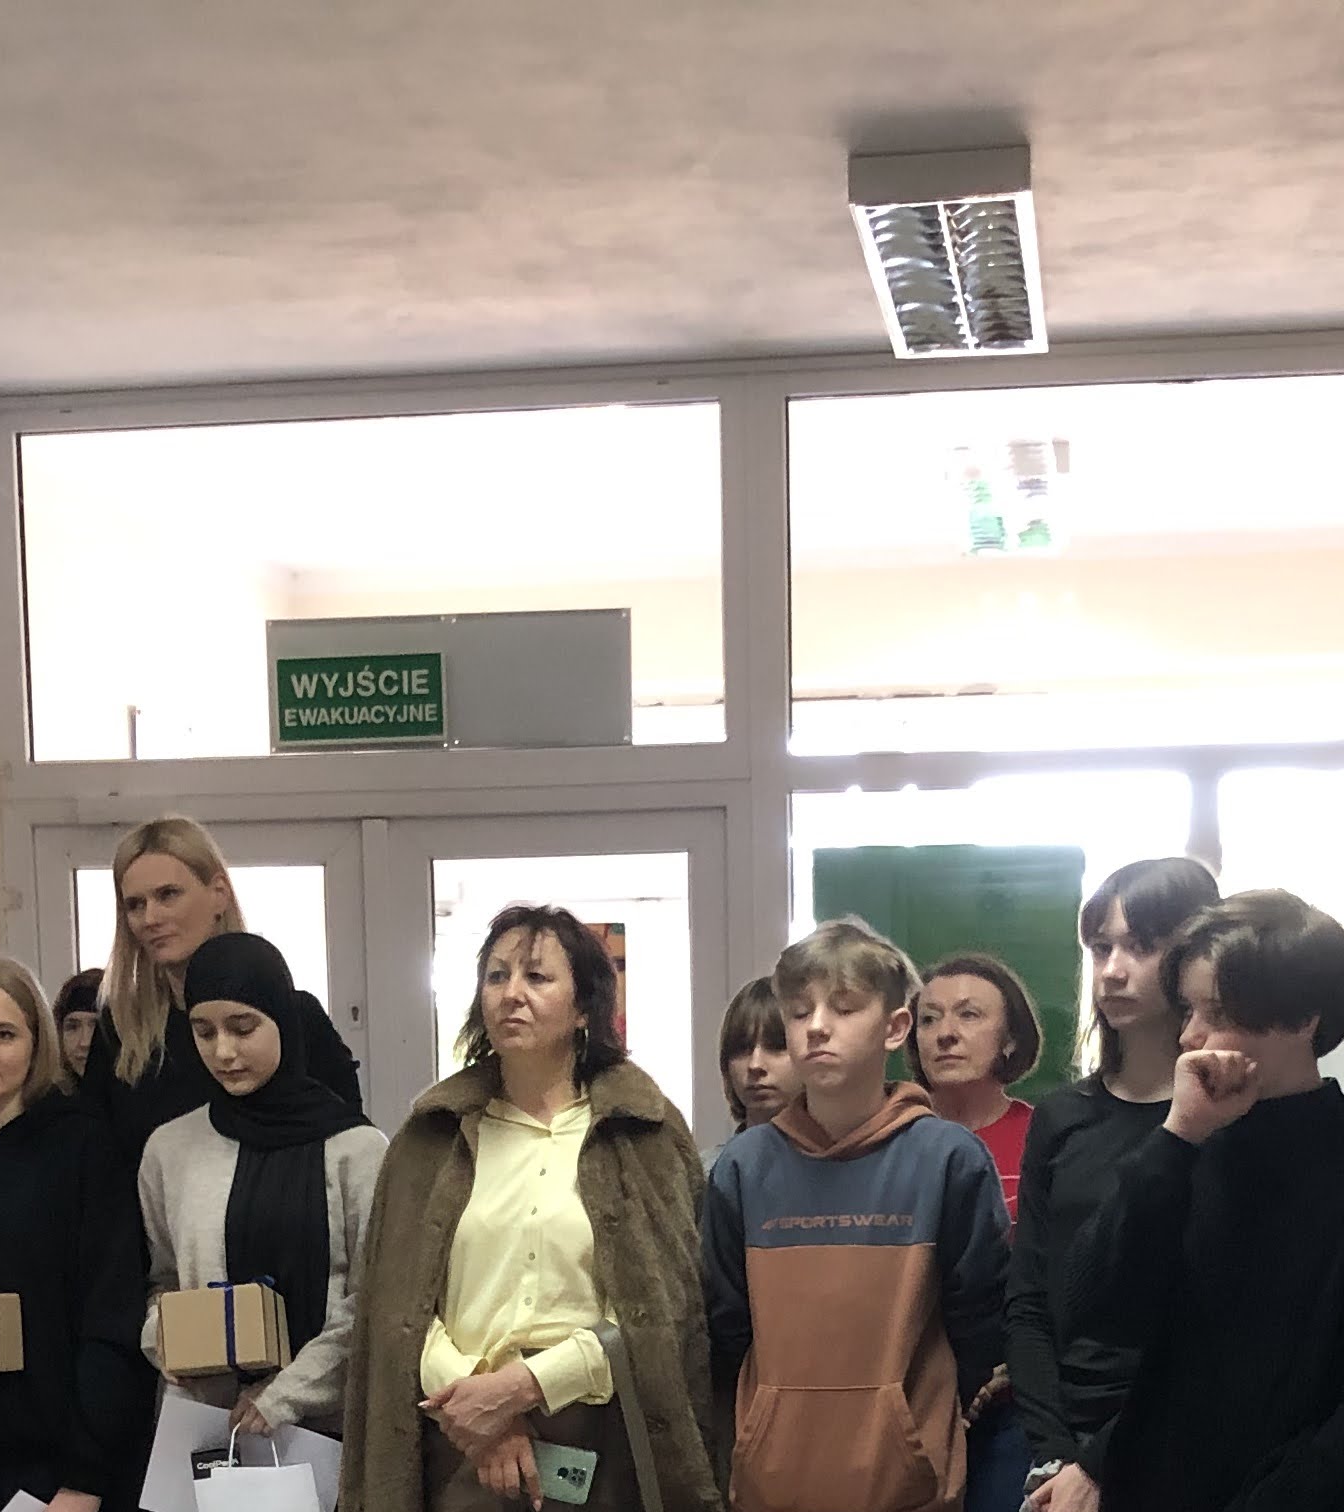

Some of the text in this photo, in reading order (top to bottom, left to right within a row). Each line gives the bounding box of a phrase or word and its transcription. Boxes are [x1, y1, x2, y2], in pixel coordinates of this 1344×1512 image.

[291, 666, 429, 699] WYJŚCIE
[285, 703, 437, 727] EWAKUACYJNE
[778, 1213, 914, 1230] SPORTSWEAR
